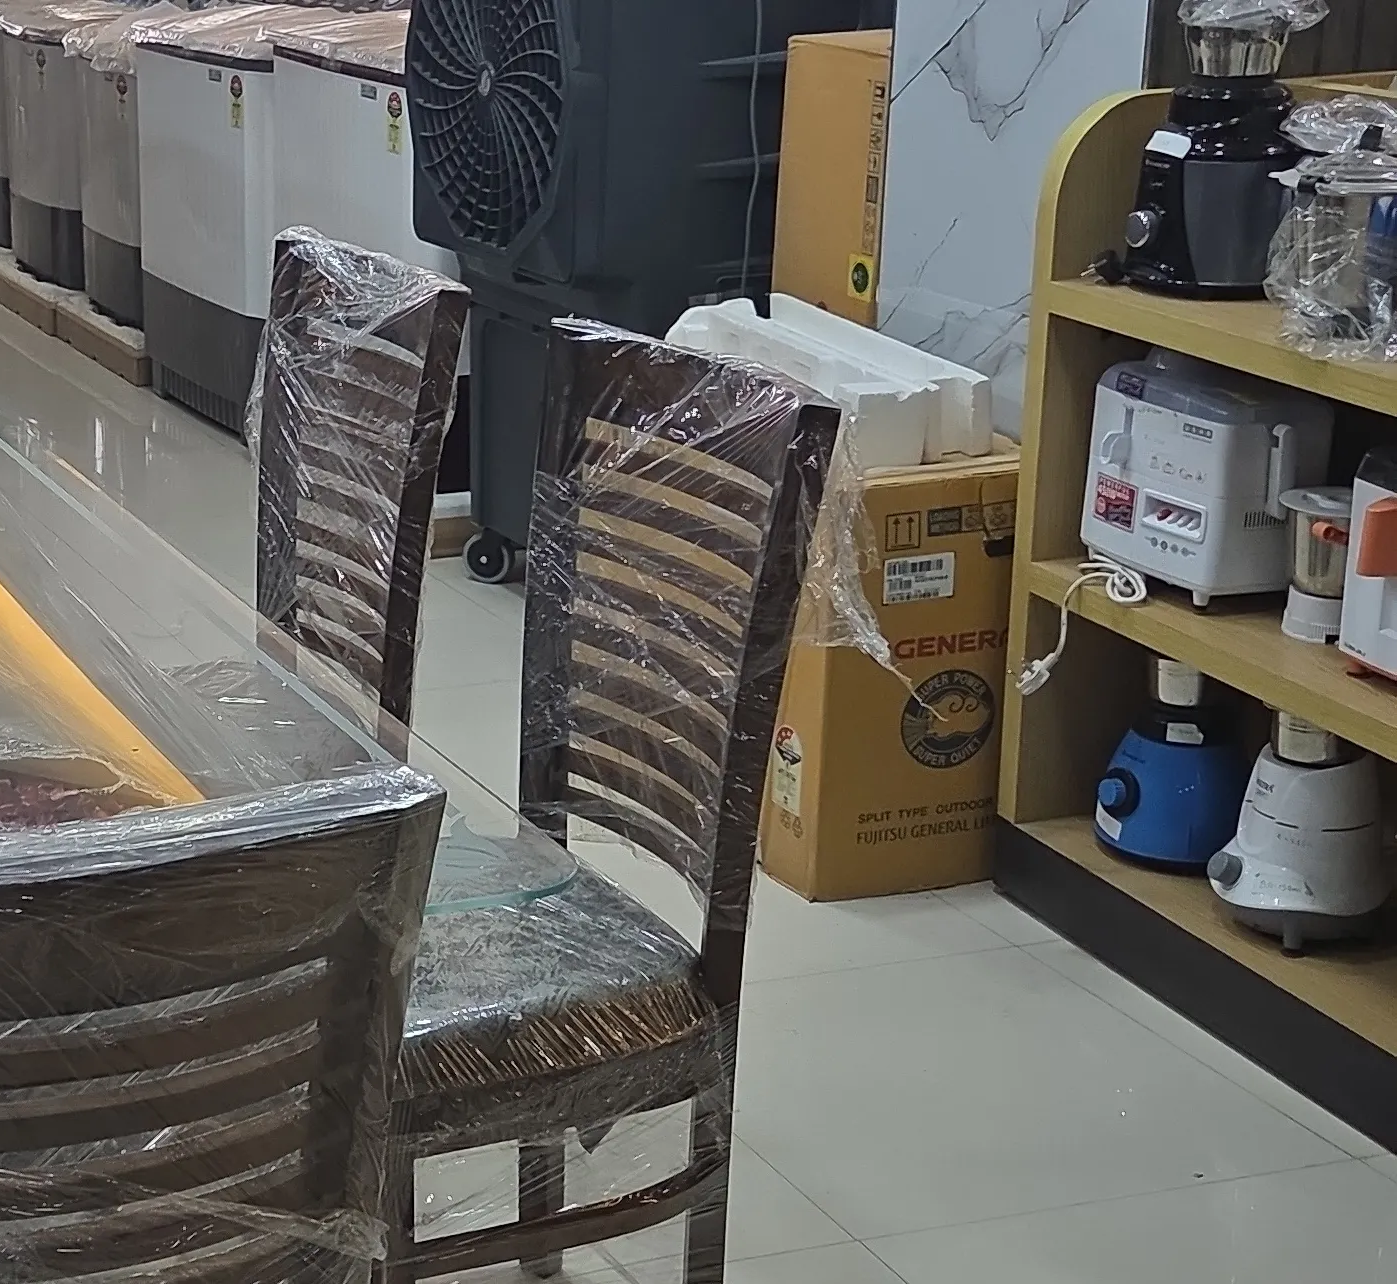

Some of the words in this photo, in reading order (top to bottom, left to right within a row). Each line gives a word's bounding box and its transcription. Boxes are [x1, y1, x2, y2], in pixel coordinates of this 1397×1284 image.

[953, 672, 988, 696] POWER
[913, 744, 947, 766] SUPER
[950, 737, 983, 764] QUIET
[857, 810, 892, 824] SPLIT
[897, 806, 929, 819] TYPE
[935, 797, 994, 815] OUTDOOR
[856, 826, 908, 845] FUJITSU
[910, 819, 971, 838] GENERAL
